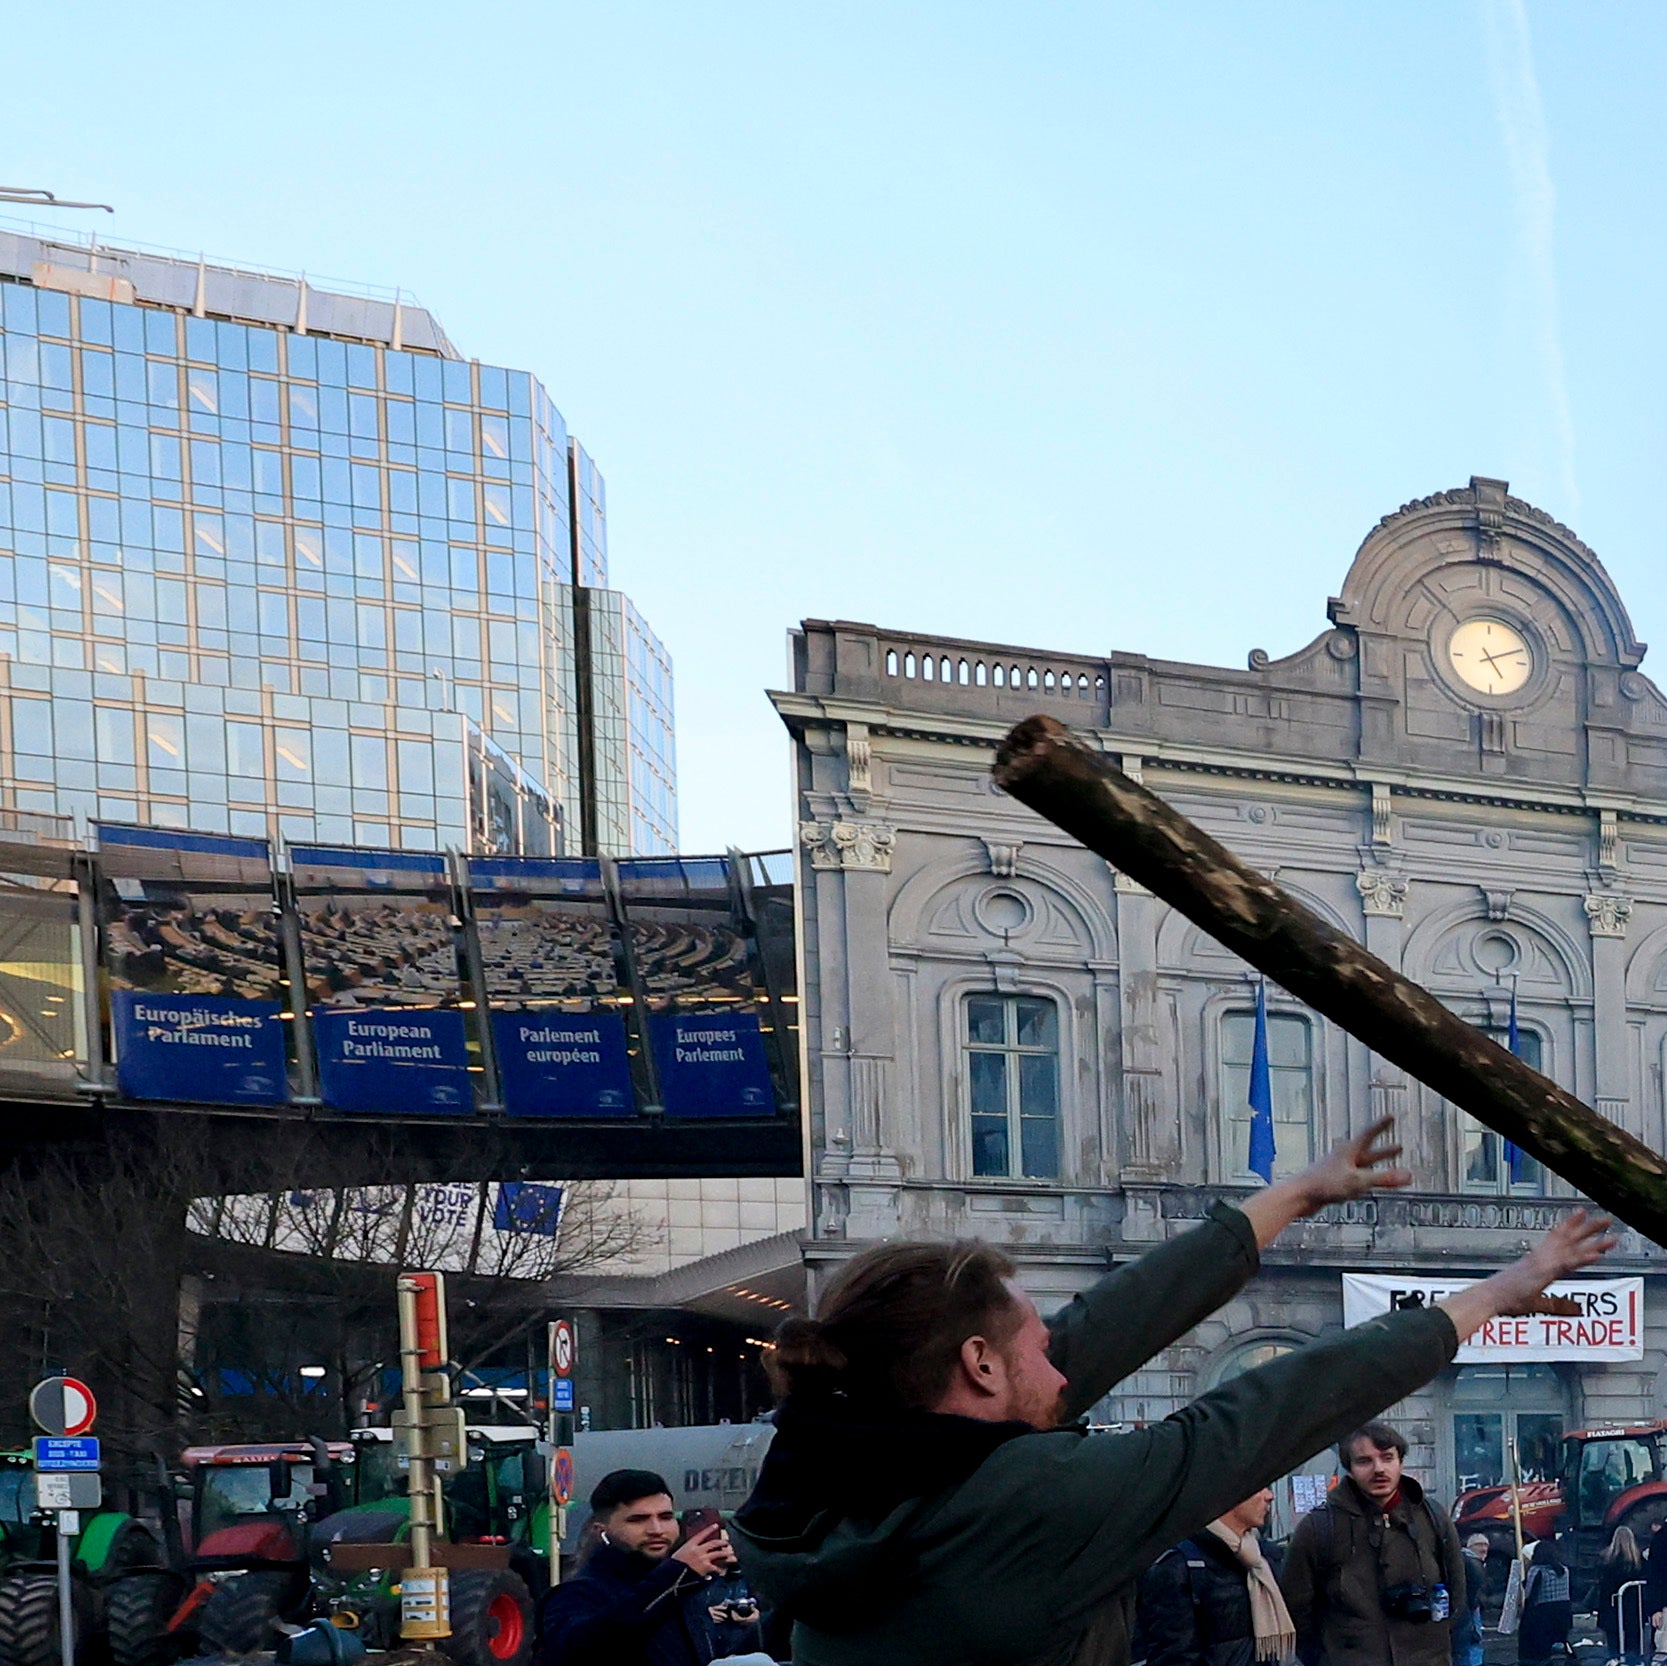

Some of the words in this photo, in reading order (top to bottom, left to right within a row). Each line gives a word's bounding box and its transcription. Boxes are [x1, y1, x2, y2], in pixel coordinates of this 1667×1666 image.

[134, 1004, 263, 1029] Europäisches
[148, 1026, 253, 1049] Parlament
[348, 1021, 432, 1040] European
[519, 1027, 601, 1044] Parlement
[677, 1028, 736, 1044] Europees
[342, 1041, 442, 1060] Parliament
[526, 1047, 600, 1066] européen
[676, 1047, 745, 1063] Parlement
[418, 1204, 467, 1226] VOTE
[1587, 1429, 1625, 1438] FIATAGRI
